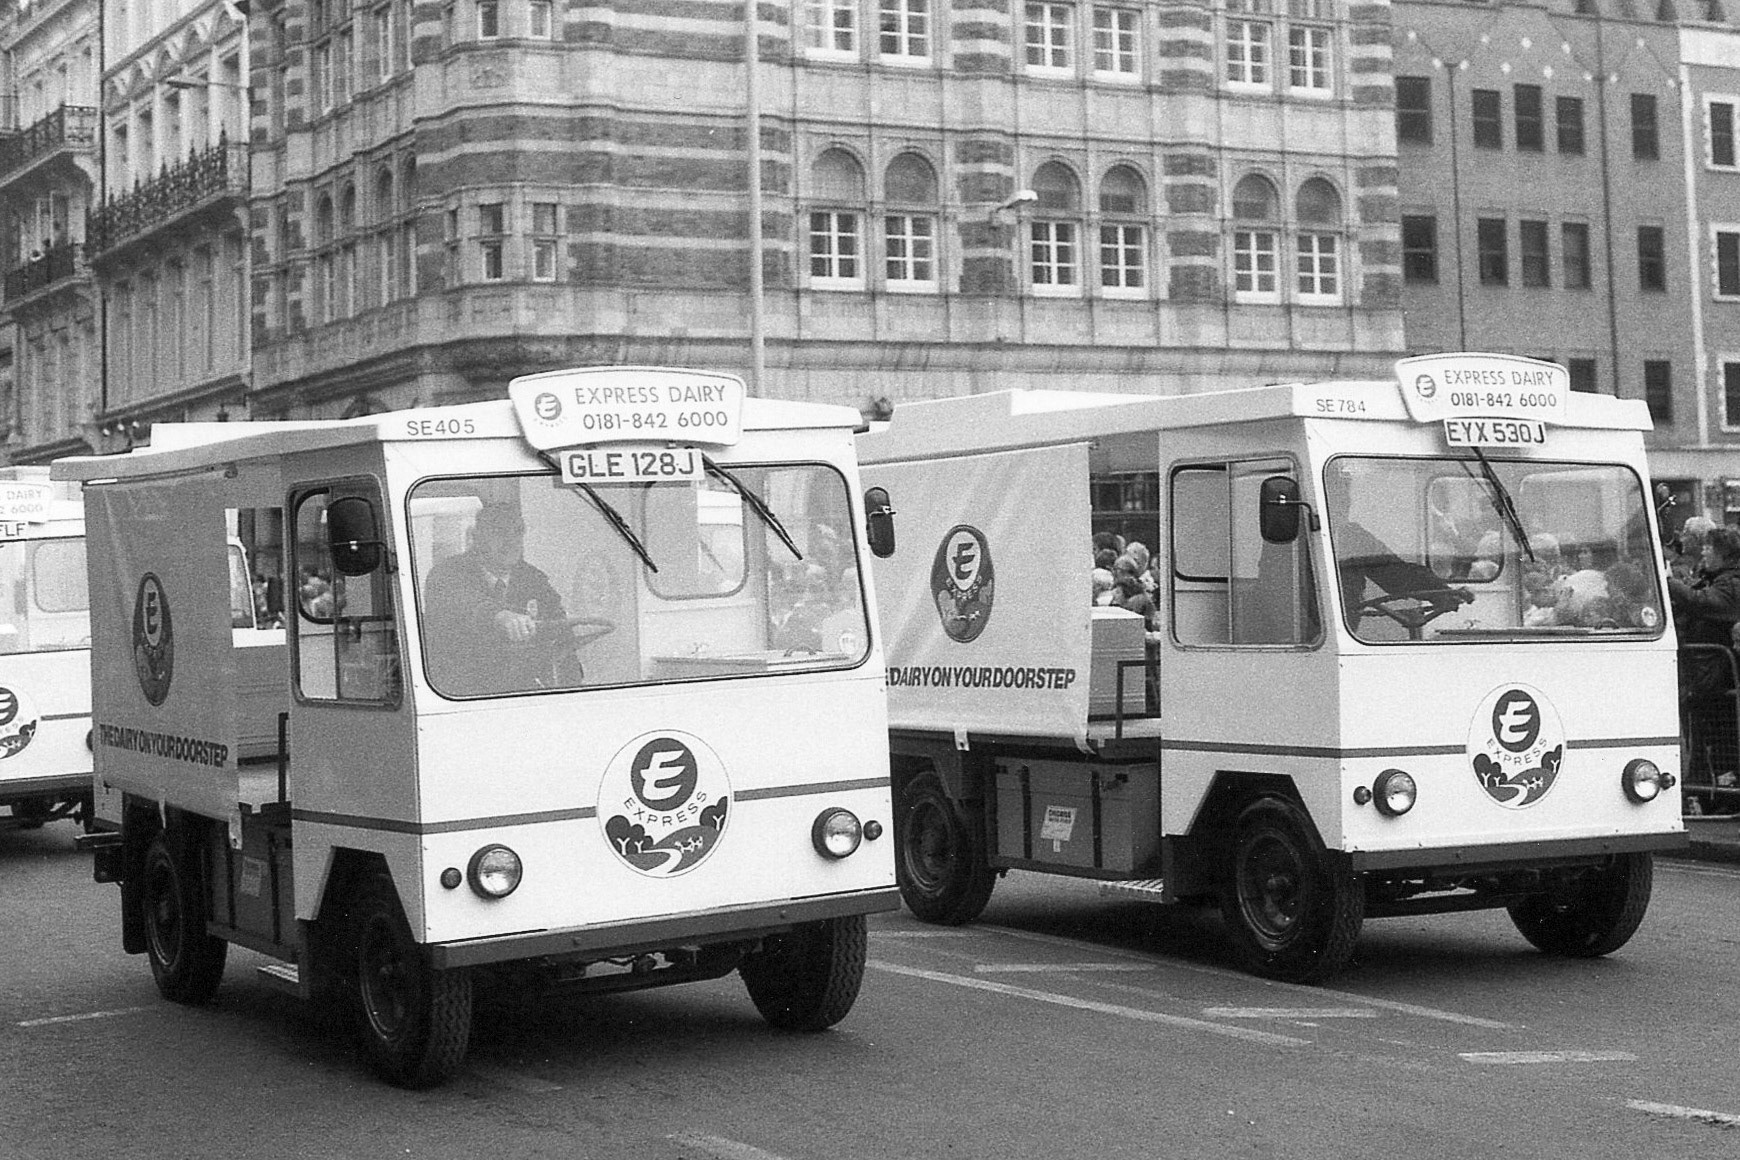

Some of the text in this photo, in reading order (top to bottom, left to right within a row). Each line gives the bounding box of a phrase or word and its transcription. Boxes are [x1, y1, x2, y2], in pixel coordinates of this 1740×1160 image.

[1444, 368, 1554, 386] EXPRESS DAIRY
[575, 385, 725, 404] EXPRESS DAIRY
[1451, 392, 1513, 408] 0181-842
[1519, 393, 1557, 408] 6000
[1316, 399, 1366, 413] SE784
[407, 419, 475, 437] SE405
[583, 413, 668, 431] 0181-842
[677, 412, 728, 428] 6000
[1449, 421, 1545, 444] EYX 530J
[568, 453, 694, 478] GLE 128J
[7, 489, 42, 500] DAIRY
[1486, 738, 1547, 766] EXPRESS
[624, 791, 707, 827] EXPRESS
